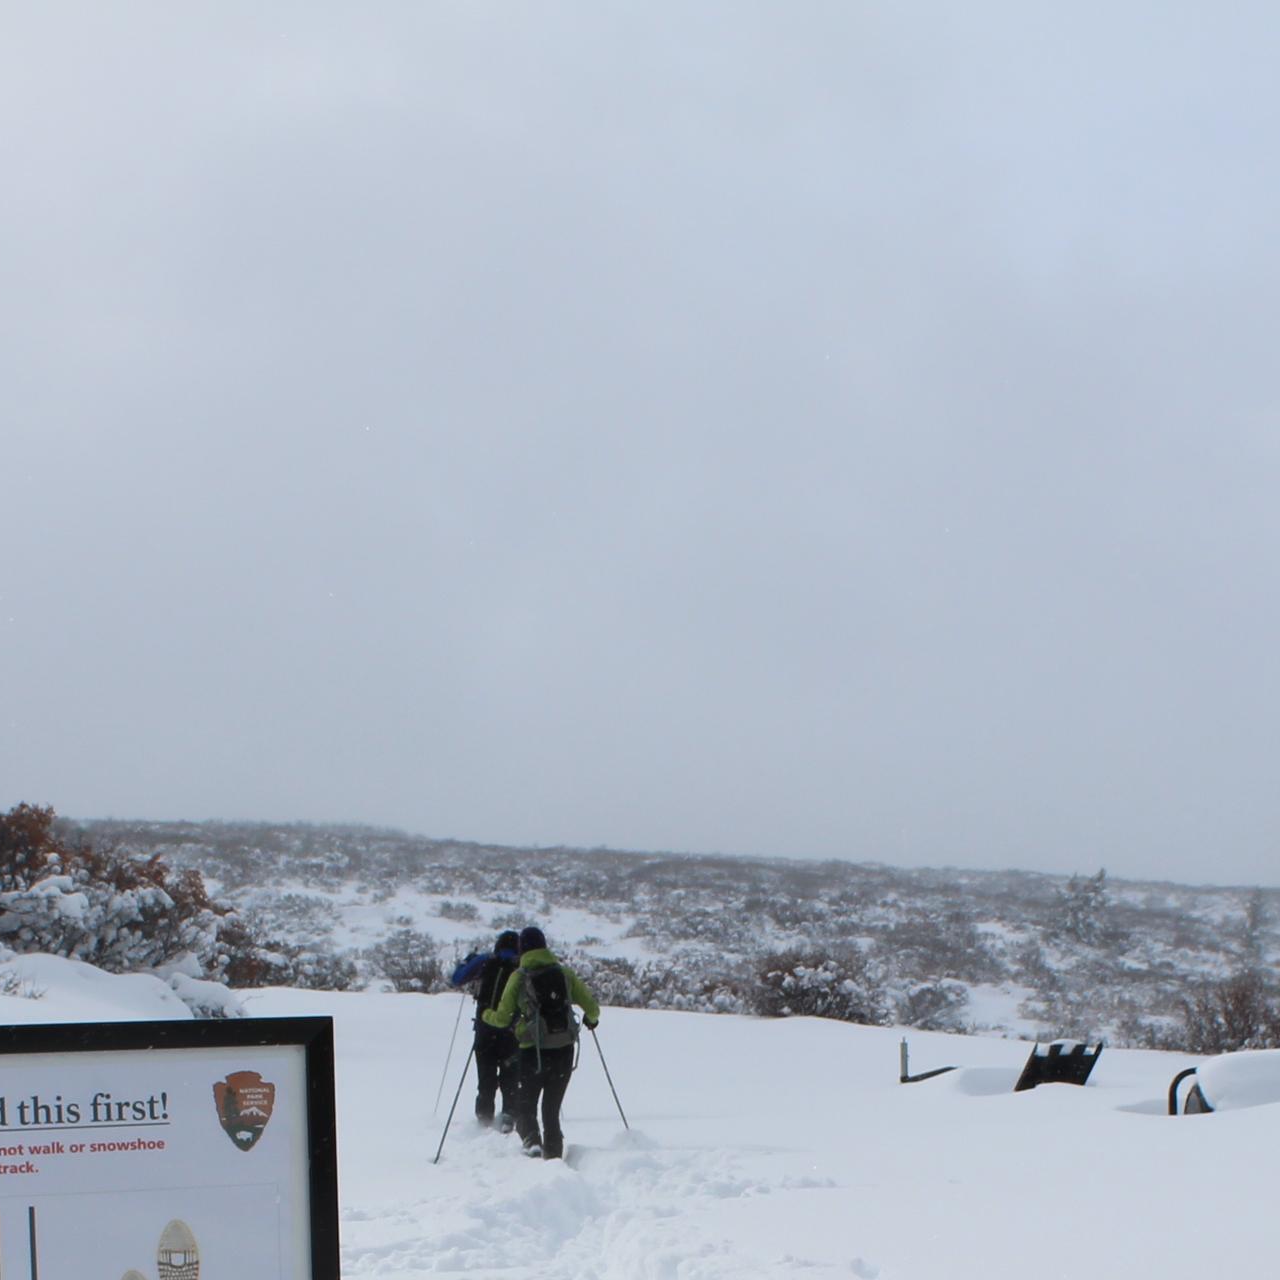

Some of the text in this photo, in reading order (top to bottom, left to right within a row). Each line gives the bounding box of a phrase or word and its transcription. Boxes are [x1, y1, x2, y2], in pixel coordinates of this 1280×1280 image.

[17, 1095, 81, 1126] this
[90, 1091, 169, 1123] first!
[28, 1141, 65, 1155] walk
[69, 1143, 86, 1153] or
[89, 1138, 166, 1152] snowshoe
